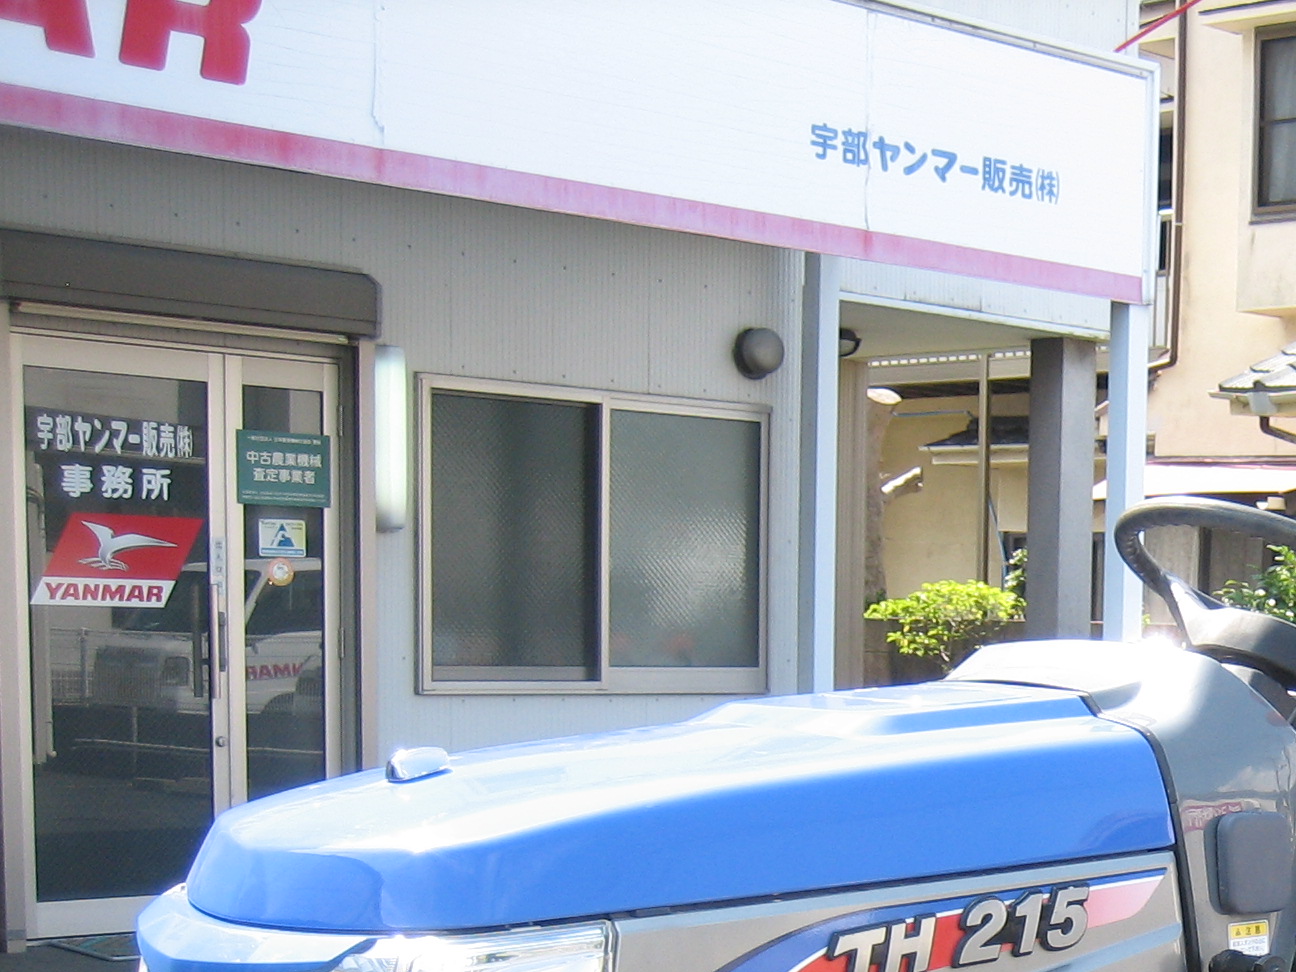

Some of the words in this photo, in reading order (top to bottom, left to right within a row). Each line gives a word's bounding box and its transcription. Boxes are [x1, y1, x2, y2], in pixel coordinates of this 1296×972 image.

[60, 463, 172, 501] 事務所
[45, 582, 164, 602] YANMAR
[951, 881, 1090, 968] 215
